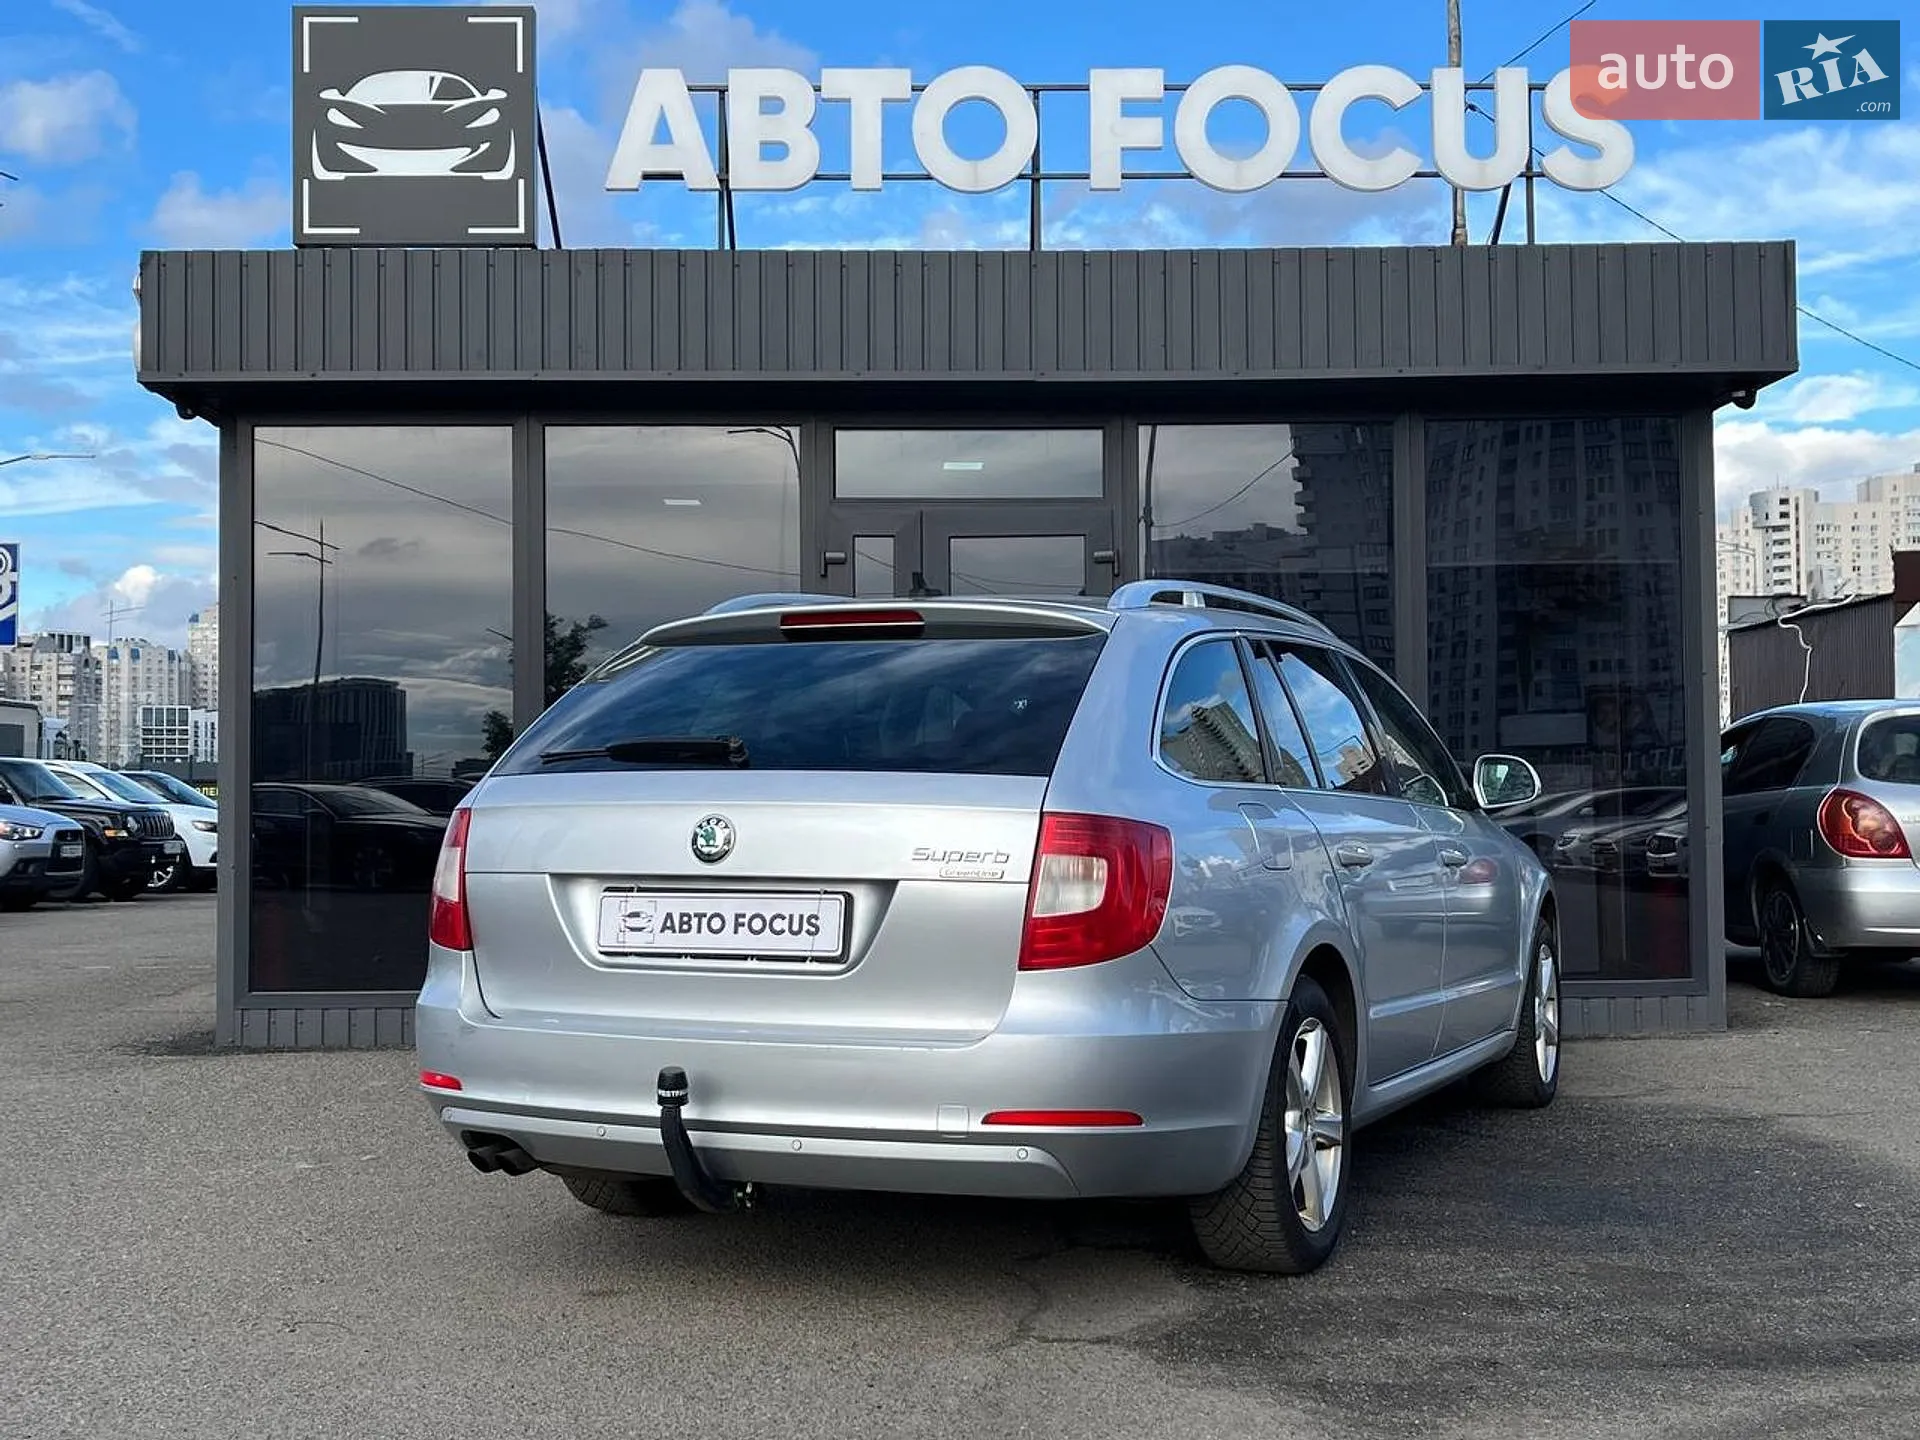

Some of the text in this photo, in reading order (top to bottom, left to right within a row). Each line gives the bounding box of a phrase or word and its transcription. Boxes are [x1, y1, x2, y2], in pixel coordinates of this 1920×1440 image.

[605, 64, 1635, 193] АВТО FOCUS
[911, 847, 1011, 864] Superb
[659, 911, 821, 937] АВТО FOCUS
